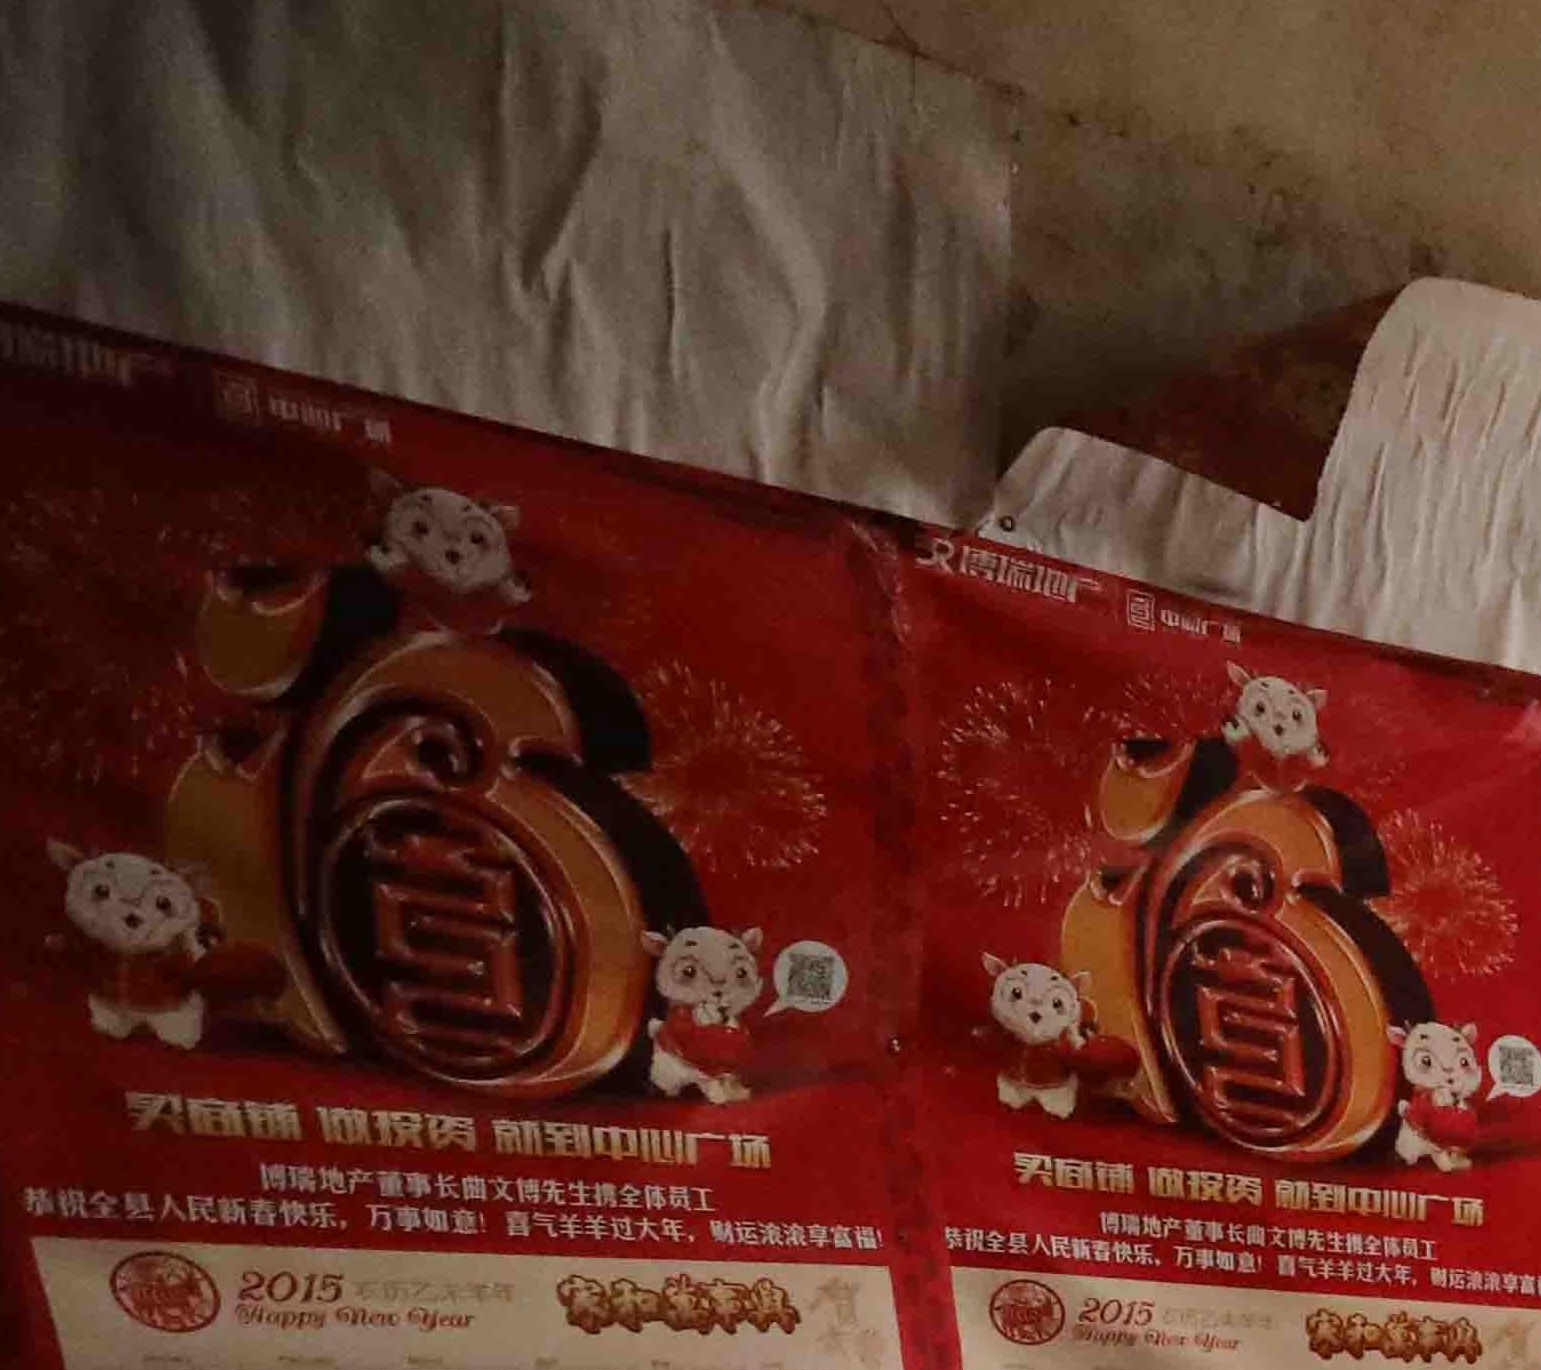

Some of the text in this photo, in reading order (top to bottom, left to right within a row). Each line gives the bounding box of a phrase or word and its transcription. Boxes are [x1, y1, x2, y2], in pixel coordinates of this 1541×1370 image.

[960, 545, 1101, 604] 博瑞地产
[125, 1091, 773, 1168] 买商铺 做投资 就到中心广场
[1014, 1152, 1484, 1227] 买商铺 做投资 就到中心广场
[236, 1271, 346, 1302] 2015
[234, 1304, 477, 1331] Happy New Year
[1077, 1297, 1156, 1327] 2015
